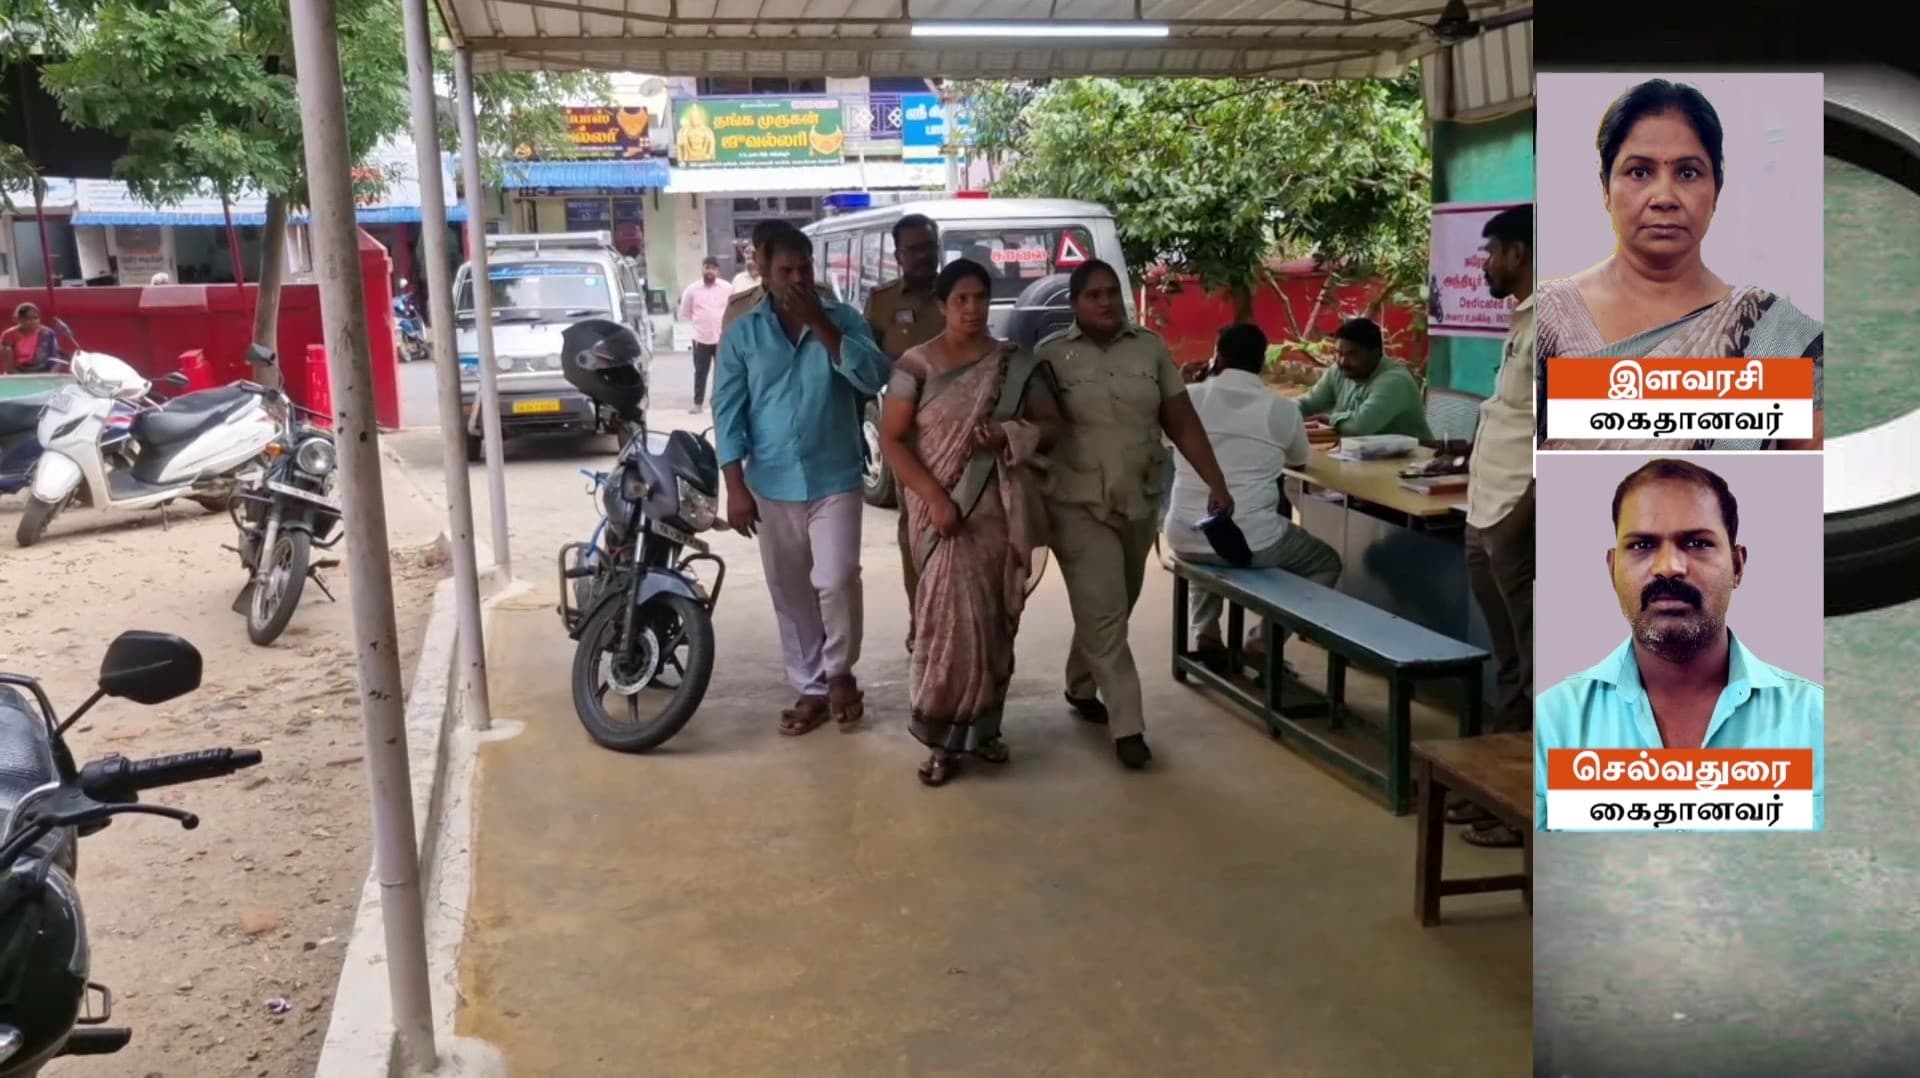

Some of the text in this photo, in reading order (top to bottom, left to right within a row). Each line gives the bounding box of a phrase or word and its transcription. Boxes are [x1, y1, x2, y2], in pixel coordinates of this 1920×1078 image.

[713, 110, 819, 129] தங்க முருகன்
[721, 131, 807, 149] ஜுவல்லரி
[1459, 296, 1504, 310] Dedicated
